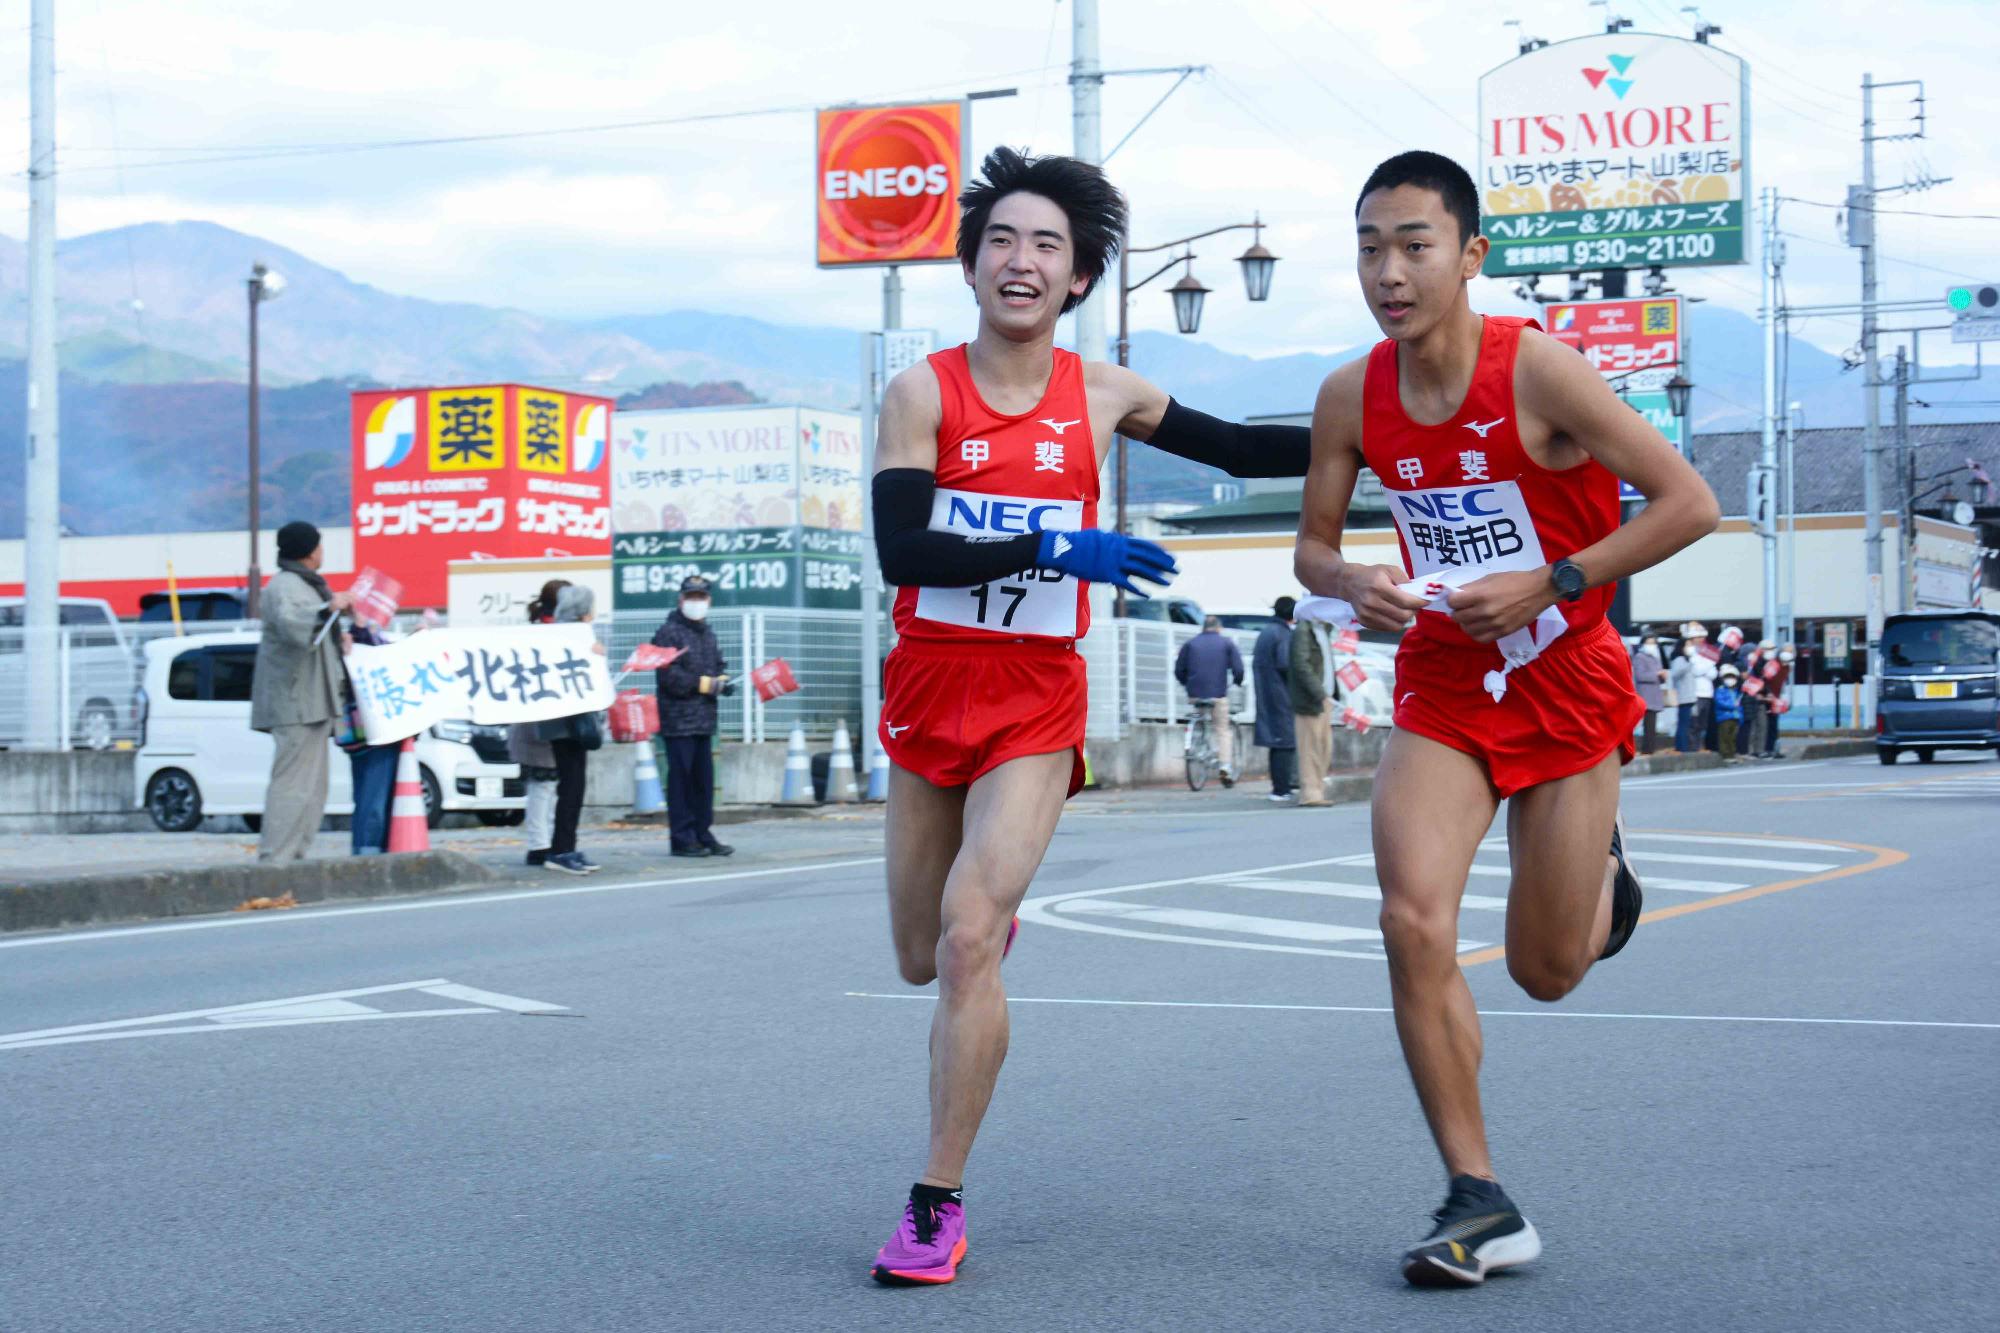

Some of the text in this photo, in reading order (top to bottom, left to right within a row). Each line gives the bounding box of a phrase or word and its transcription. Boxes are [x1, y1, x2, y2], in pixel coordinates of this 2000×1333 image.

[1572, 102, 1732, 151] MORE
[825, 163, 949, 200] ENEOS
[439, 396, 494, 464] 薬
[526, 398, 560, 465] 薬
[961, 439, 1064, 474] 甲 斐
[1396, 449, 1490, 488] 甲 斐
[947, 496, 1063, 535] NEC
[1398, 488, 1504, 522] NEC
[1408, 517, 1525, 567] 甲斐市B
[479, 592, 540, 614] クリー
[969, 582, 1028, 628] 17
[455, 648, 595, 704] 北杜市
